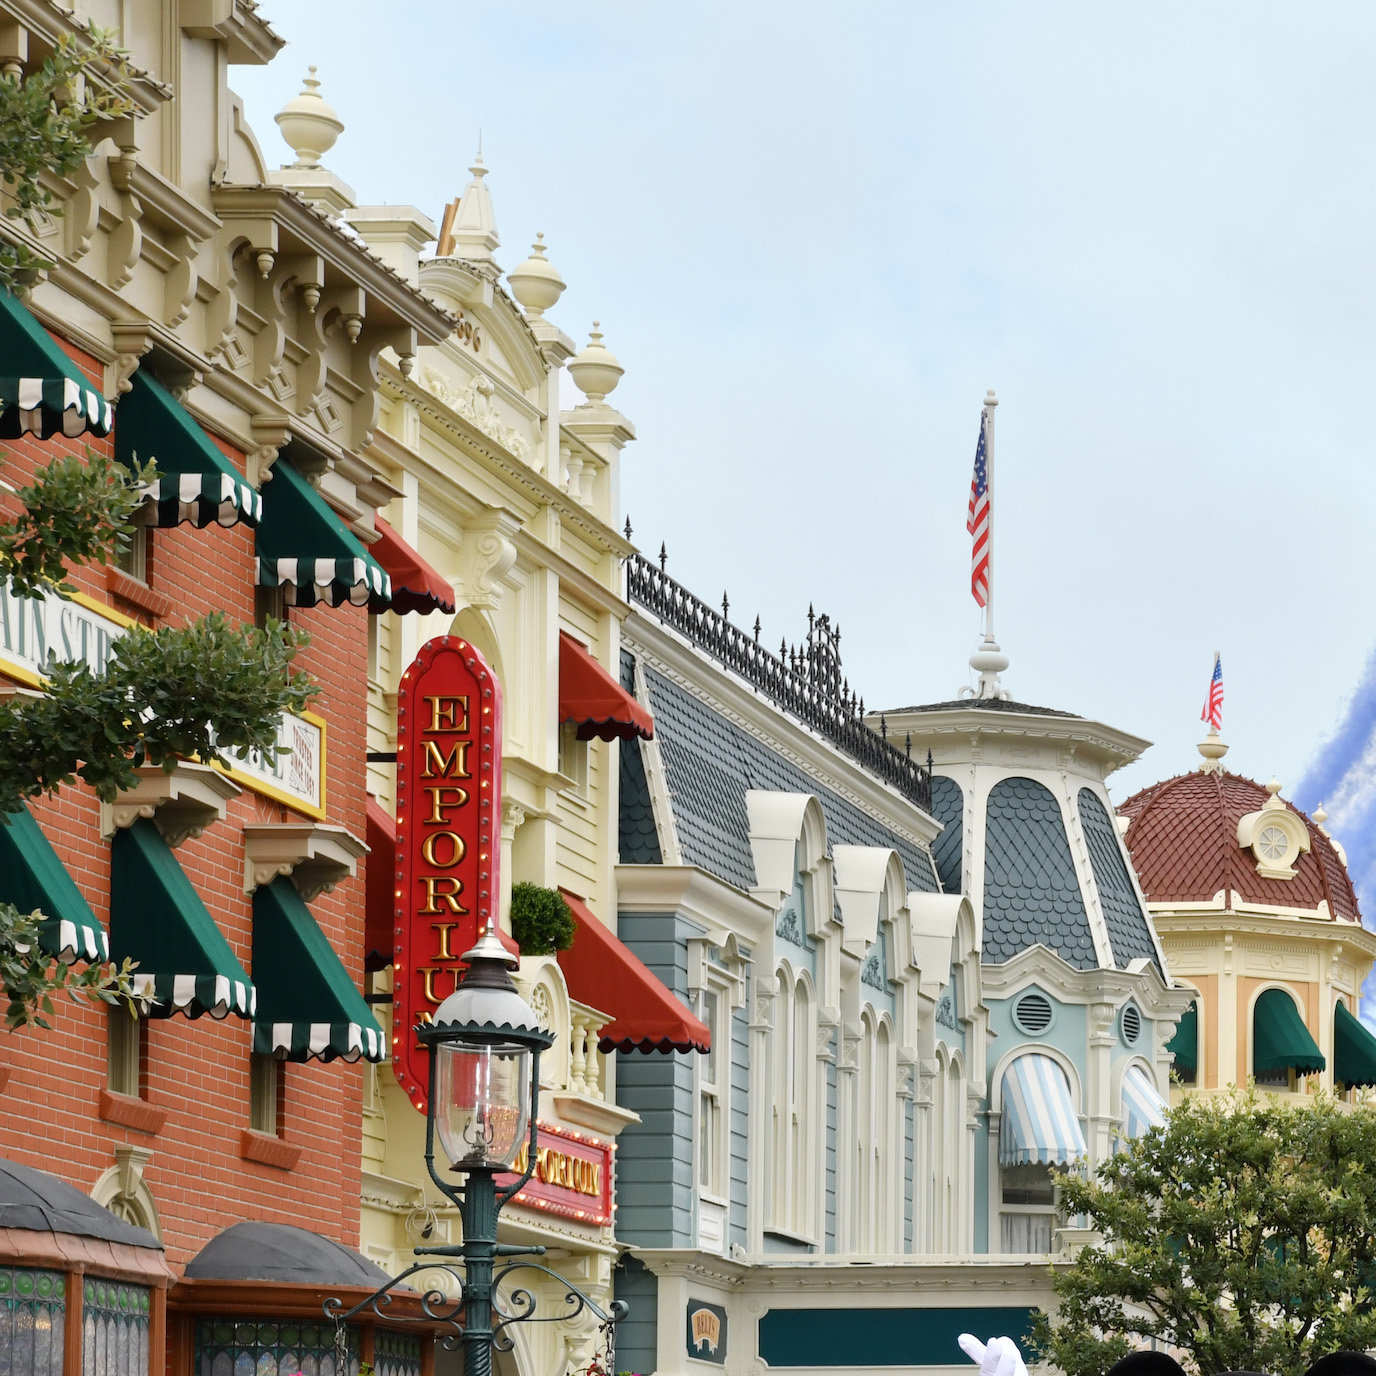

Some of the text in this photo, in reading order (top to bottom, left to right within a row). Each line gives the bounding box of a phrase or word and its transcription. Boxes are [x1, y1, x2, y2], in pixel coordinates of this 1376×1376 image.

[0, 580, 114, 678] AIN STR
[291, 751, 303, 781] SINCE
[293, 724, 312, 771] TRUSTED
[415, 695, 473, 1050] EMPORIU
[511, 1141, 601, 1196] MORIUM
